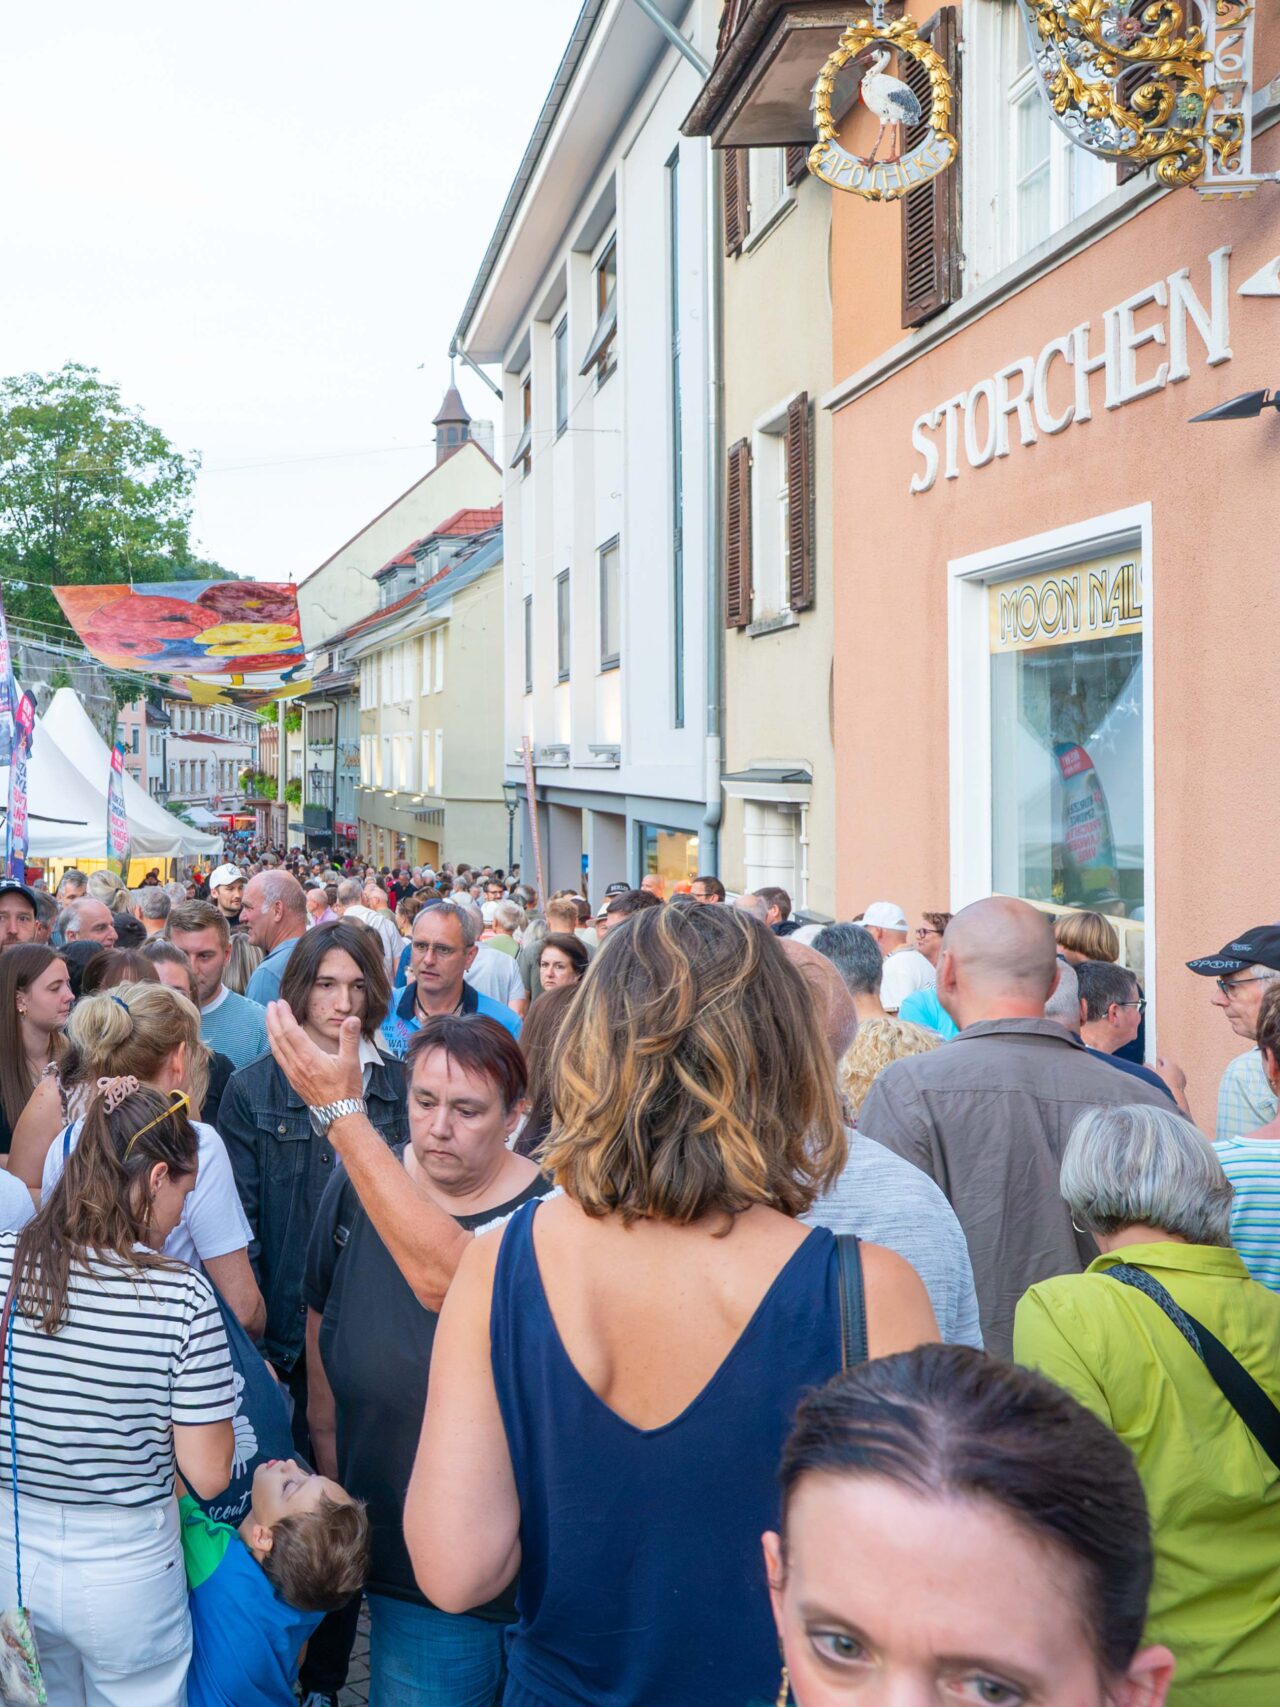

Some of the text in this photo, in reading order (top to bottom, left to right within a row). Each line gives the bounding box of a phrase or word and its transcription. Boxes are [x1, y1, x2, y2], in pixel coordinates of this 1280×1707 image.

[819, 141, 945, 190] APOTHEKE
[910, 245, 1234, 495] STORCHEN
[1000, 563, 1142, 641] MOON NAIL
[1188, 959, 1243, 969] SPORT
[208, 1490, 253, 1521] scout
